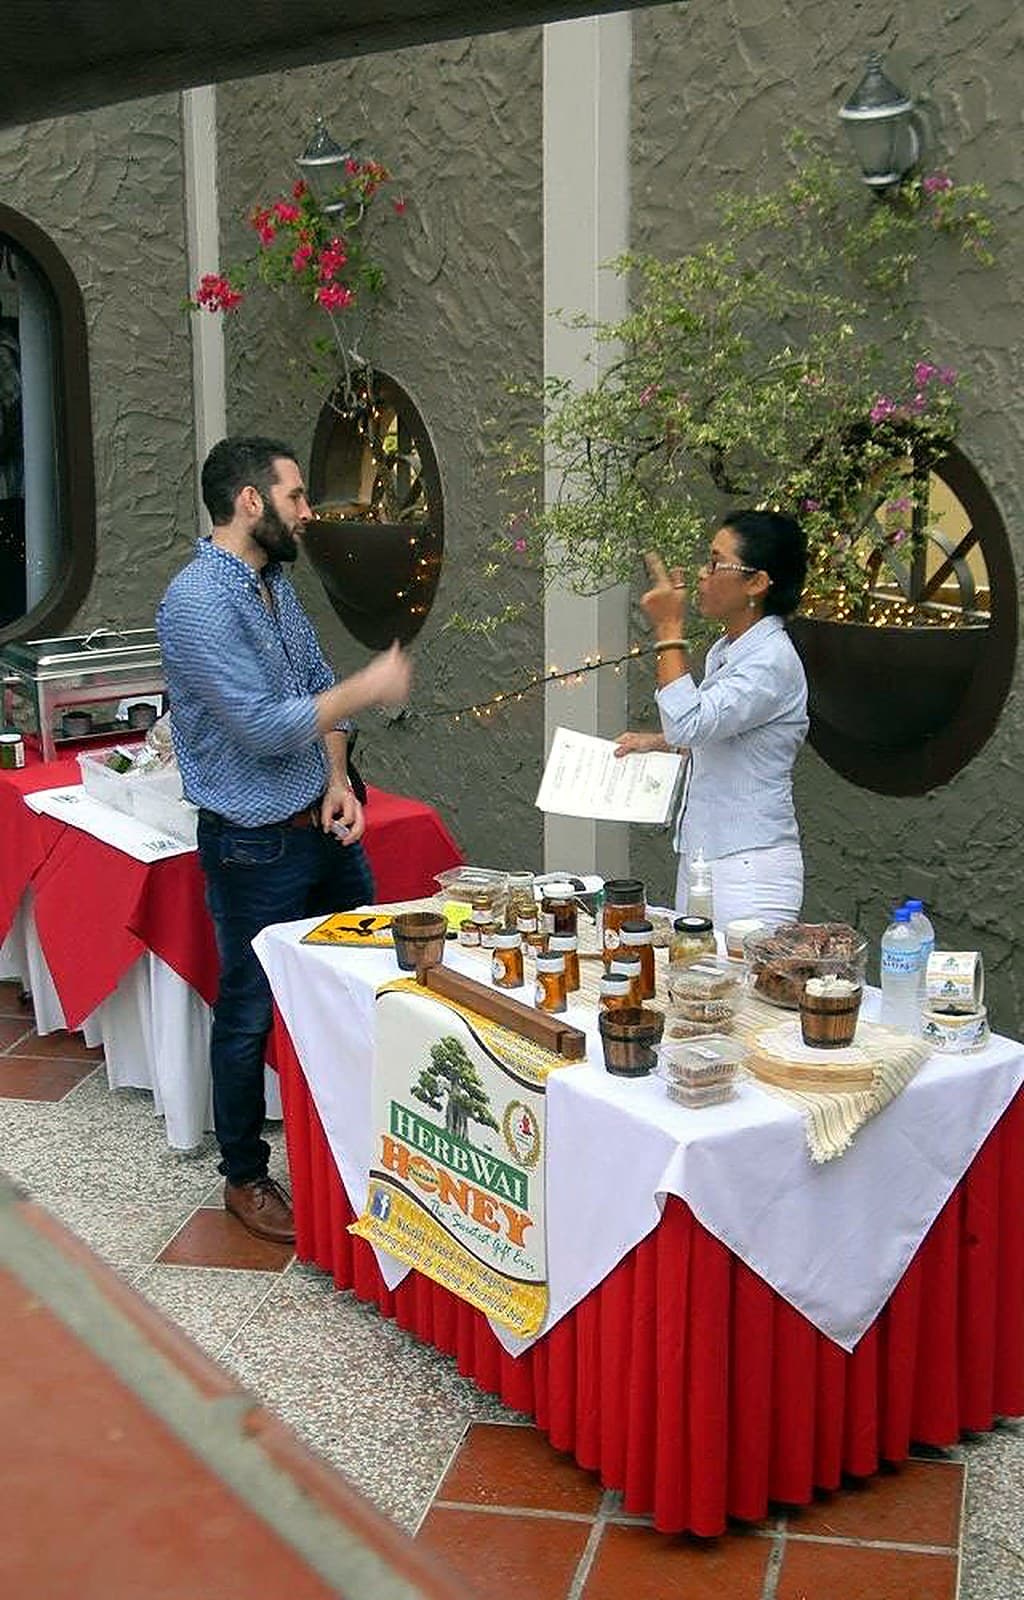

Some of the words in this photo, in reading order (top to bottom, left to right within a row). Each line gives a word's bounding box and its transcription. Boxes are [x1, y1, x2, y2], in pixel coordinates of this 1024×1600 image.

[381, 1135, 533, 1247] HONEY
[395, 1109, 525, 1204] HERBWAI
[430, 1198, 447, 1219] The
